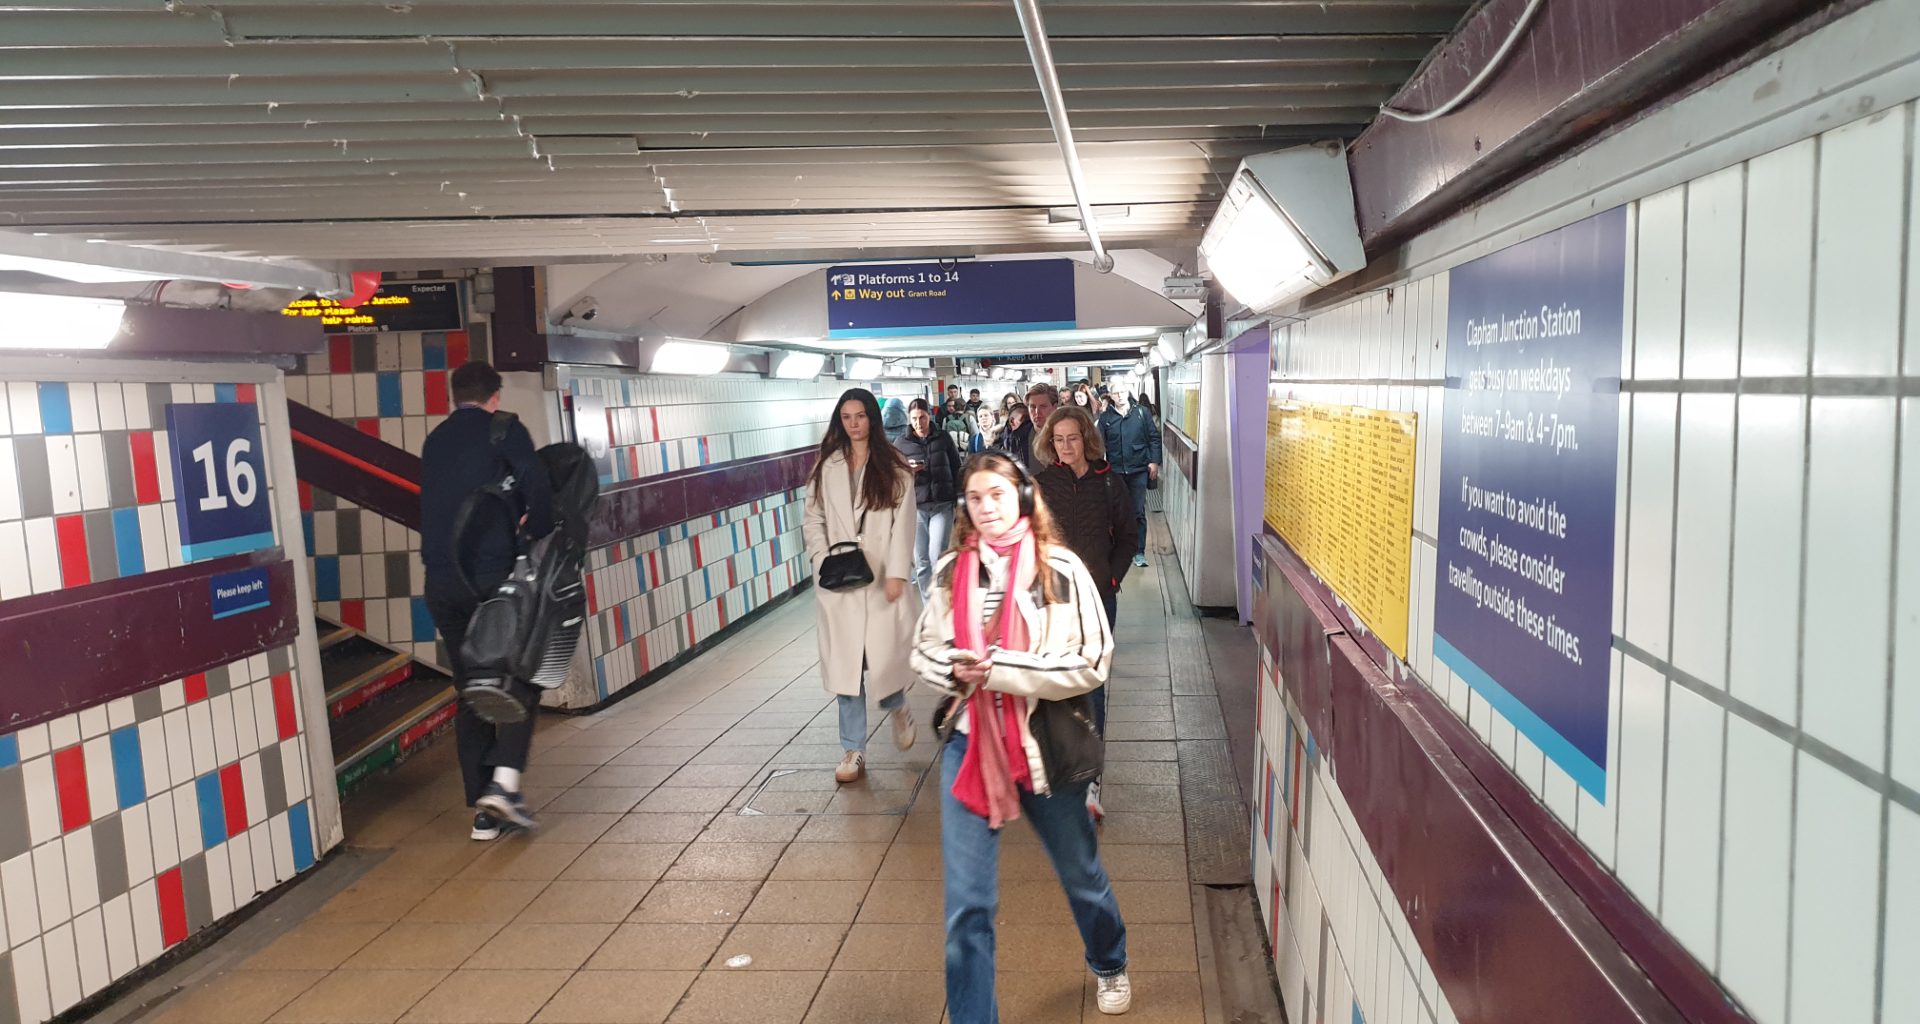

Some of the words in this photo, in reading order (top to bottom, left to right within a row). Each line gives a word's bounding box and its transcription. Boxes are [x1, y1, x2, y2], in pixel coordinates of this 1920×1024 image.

[412, 285, 446, 293] Expected
[859, 274, 915, 285] Platforms
[918, 272, 925, 283] 1
[928, 273, 941, 283] to
[944, 271, 959, 282] 14
[859, 289, 883, 300] Way
[886, 288, 905, 298] out
[372, 296, 410, 305] Junction
[348, 325, 379, 333] Platform
[1466, 318, 1498, 352] Clapham
[1499, 309, 1538, 343] Junction
[1540, 302, 1581, 338] Station
[1469, 364, 1486, 397] gets
[1487, 360, 1504, 397] busy
[1506, 368, 1519, 391] on
[1520, 358, 1571, 400] weekdays
[1461, 410, 1493, 437] between
[1526, 411, 1535, 443] &
[192, 437, 257, 512] 16
[1462, 475, 1468, 502] If
[1468, 485, 1483, 511] you
[1484, 490, 1504, 517] want
[1506, 492, 1516, 520] to
[1518, 497, 1545, 531] avoid
[1547, 501, 1567, 539] the
[1460, 525, 1489, 561] crowds,
[1490, 533, 1517, 573] please
[1520, 554, 1565, 595] consider
[217, 588, 237, 600] Please
[236, 583, 251, 595] keep
[251, 579, 263, 590] left
[1449, 560, 1482, 608] travelling
[1483, 581, 1515, 623] outside
[1517, 597, 1544, 641] these
[1547, 615, 1582, 666] times.
